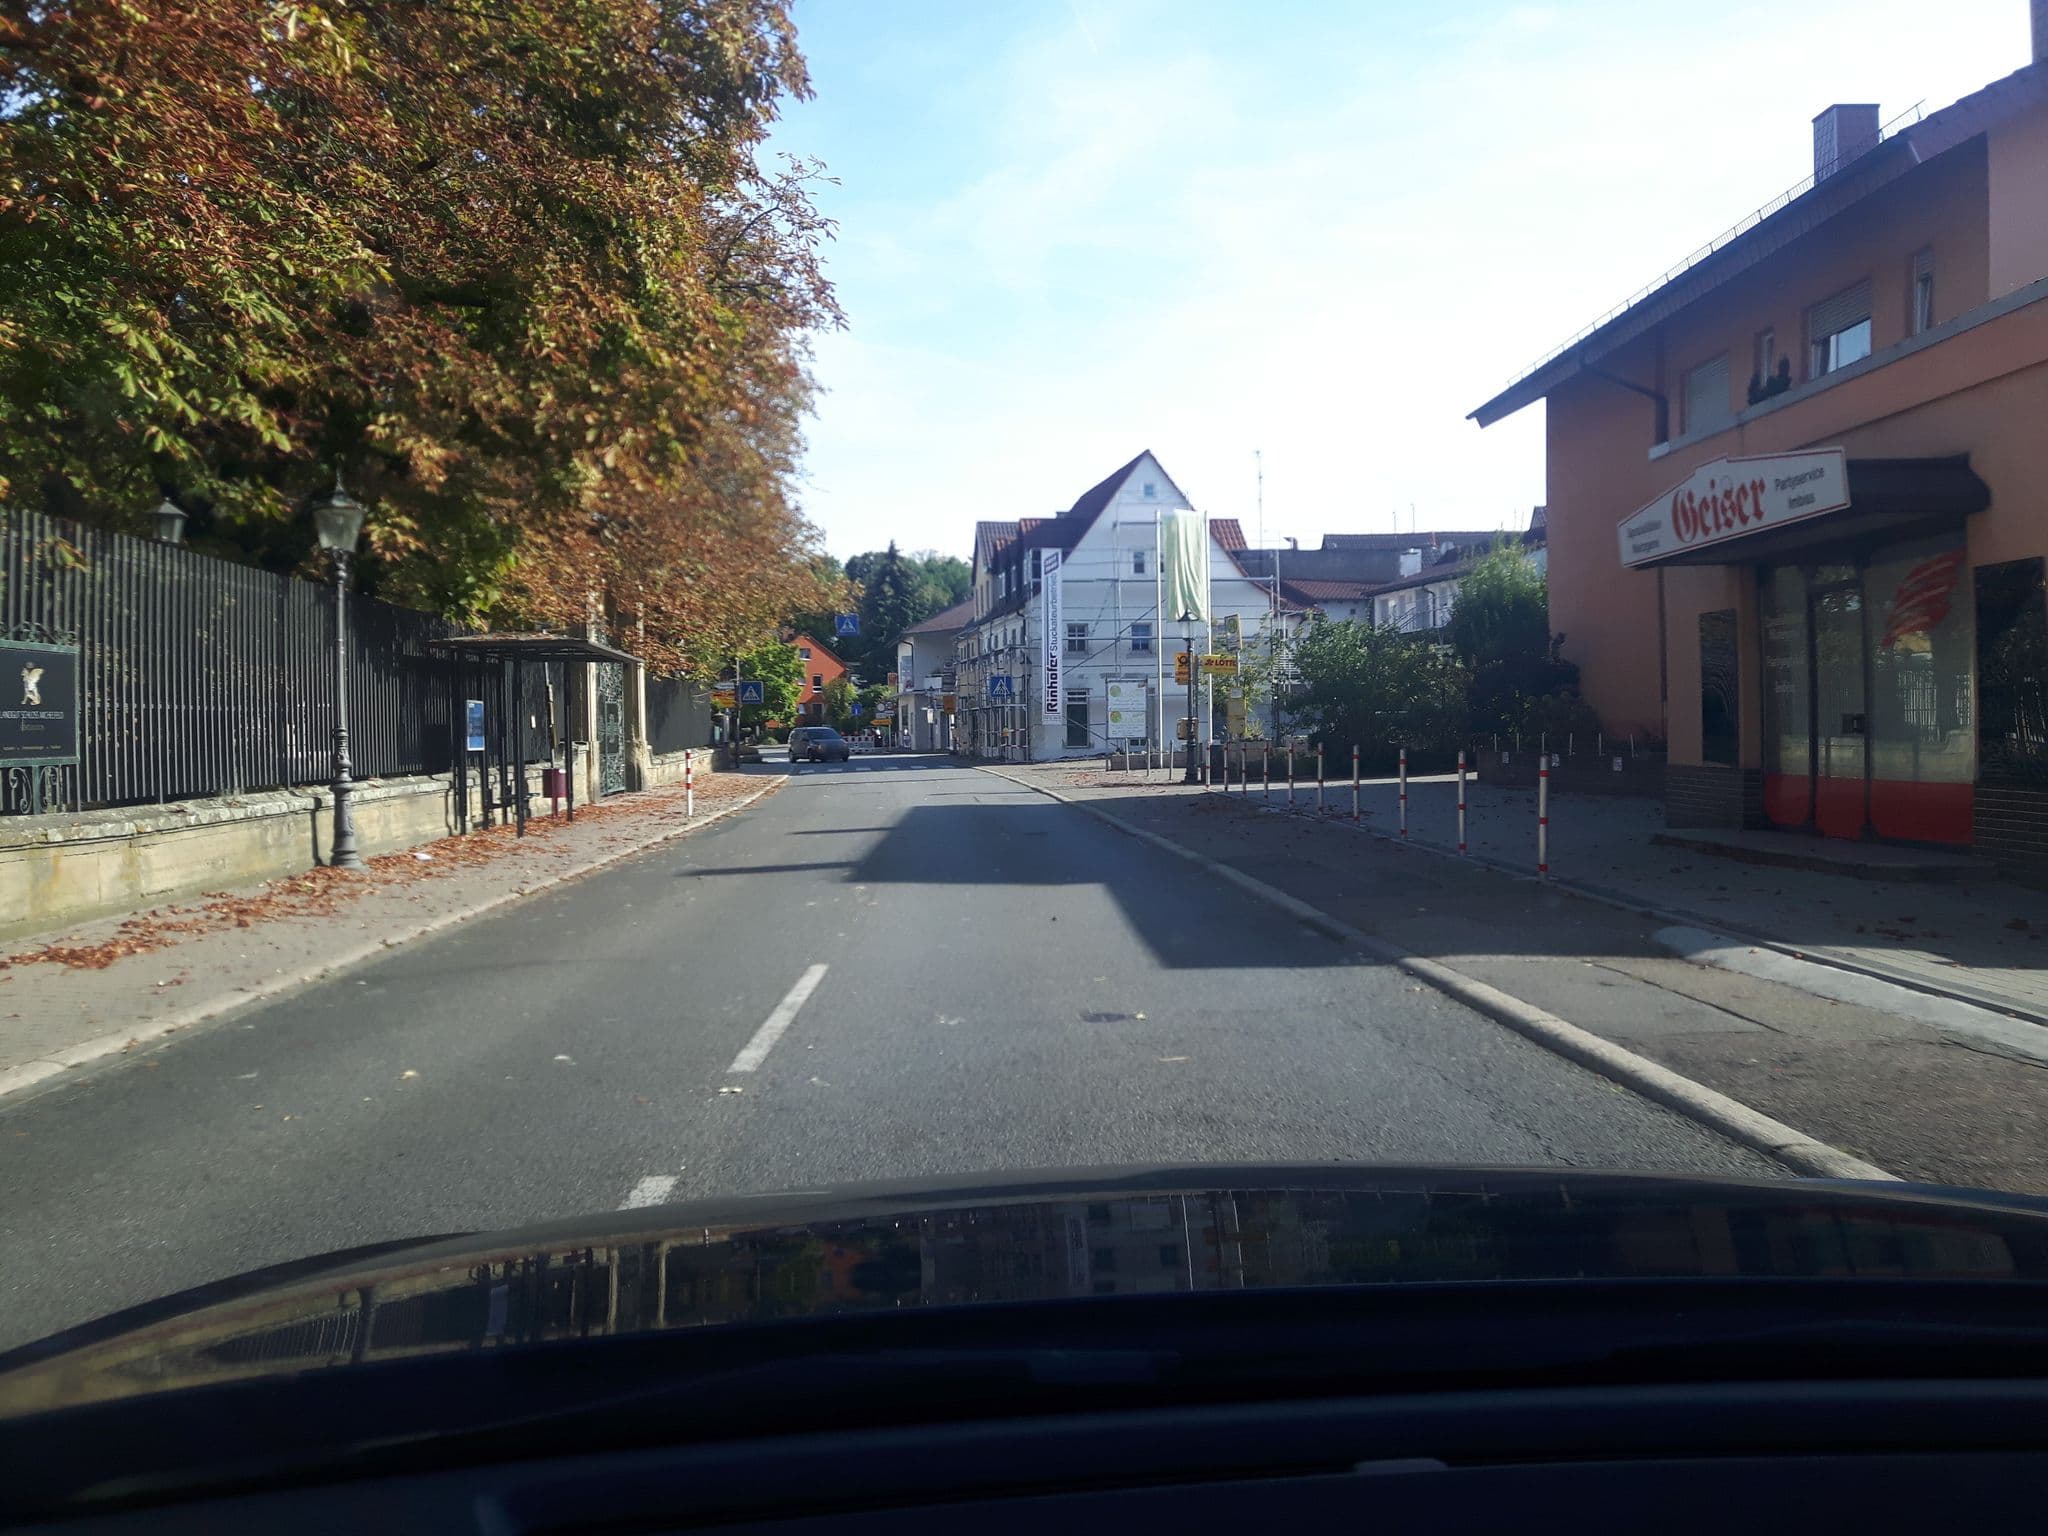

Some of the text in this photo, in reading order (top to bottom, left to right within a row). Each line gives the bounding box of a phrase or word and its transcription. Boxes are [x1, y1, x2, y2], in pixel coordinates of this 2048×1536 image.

[1671, 475, 1766, 543] Geiser
[1775, 467, 1825, 491] Partyservice
[1047, 652, 1059, 712] Rinhofer
